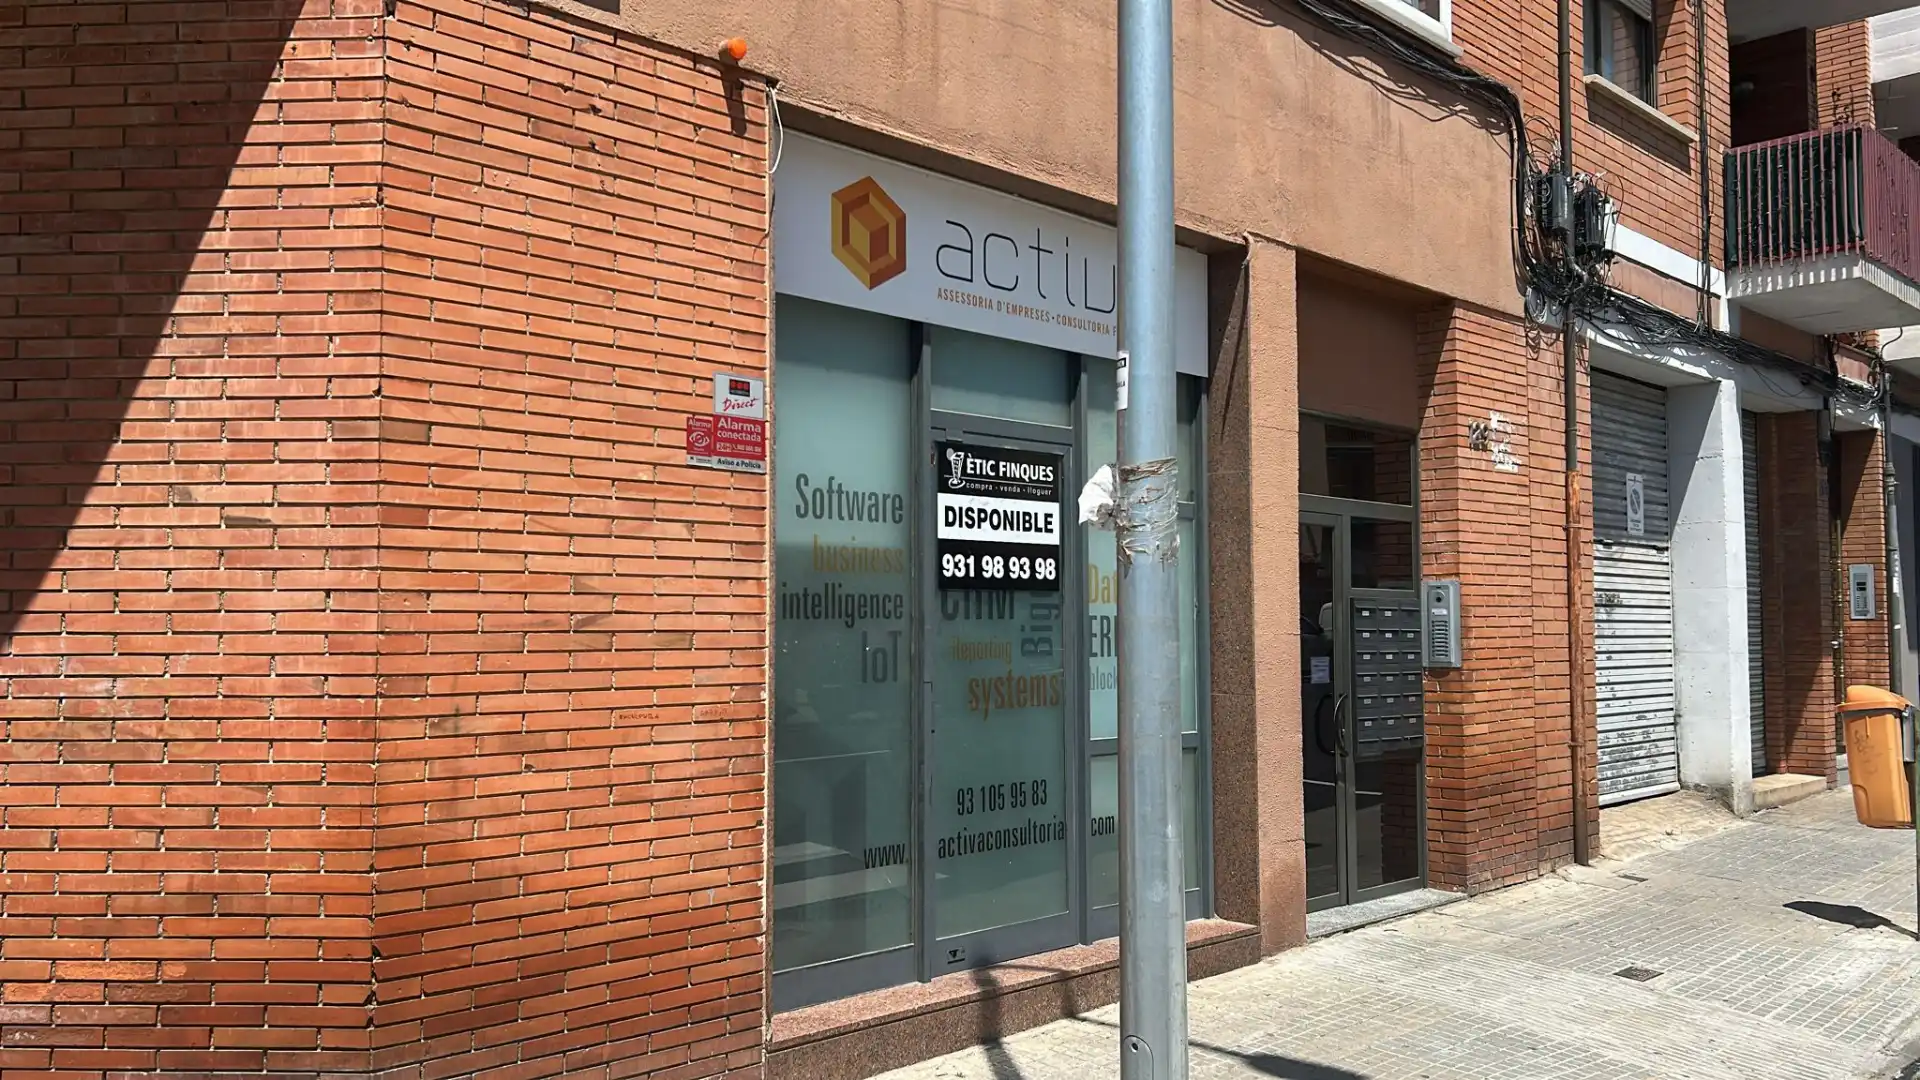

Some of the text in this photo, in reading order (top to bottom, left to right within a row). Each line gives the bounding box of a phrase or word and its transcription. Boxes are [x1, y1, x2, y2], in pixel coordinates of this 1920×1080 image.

[937, 287, 993, 311] ASSESSORIA
[1056, 314, 1110, 336] CONSULTORIA
[722, 397, 760, 412] Direct
[717, 417, 761, 433] Alarma
[717, 430, 761, 442] conectada
[717, 458, 735, 466] Aviso
[966, 453, 1054, 482] ÈTIC FINQUES
[795, 473, 904, 525] Software
[966, 482, 1052, 496] compra venda lloguer
[944, 505, 1054, 534] DISPONIBLE
[813, 533, 905, 574] business
[942, 553, 1056, 580] 931 98 93 98
[781, 581, 904, 629] intelligence
[861, 630, 903, 684] IoT
[968, 669, 1060, 722] systems
[957, 778, 1047, 816] 93 105 95 83
